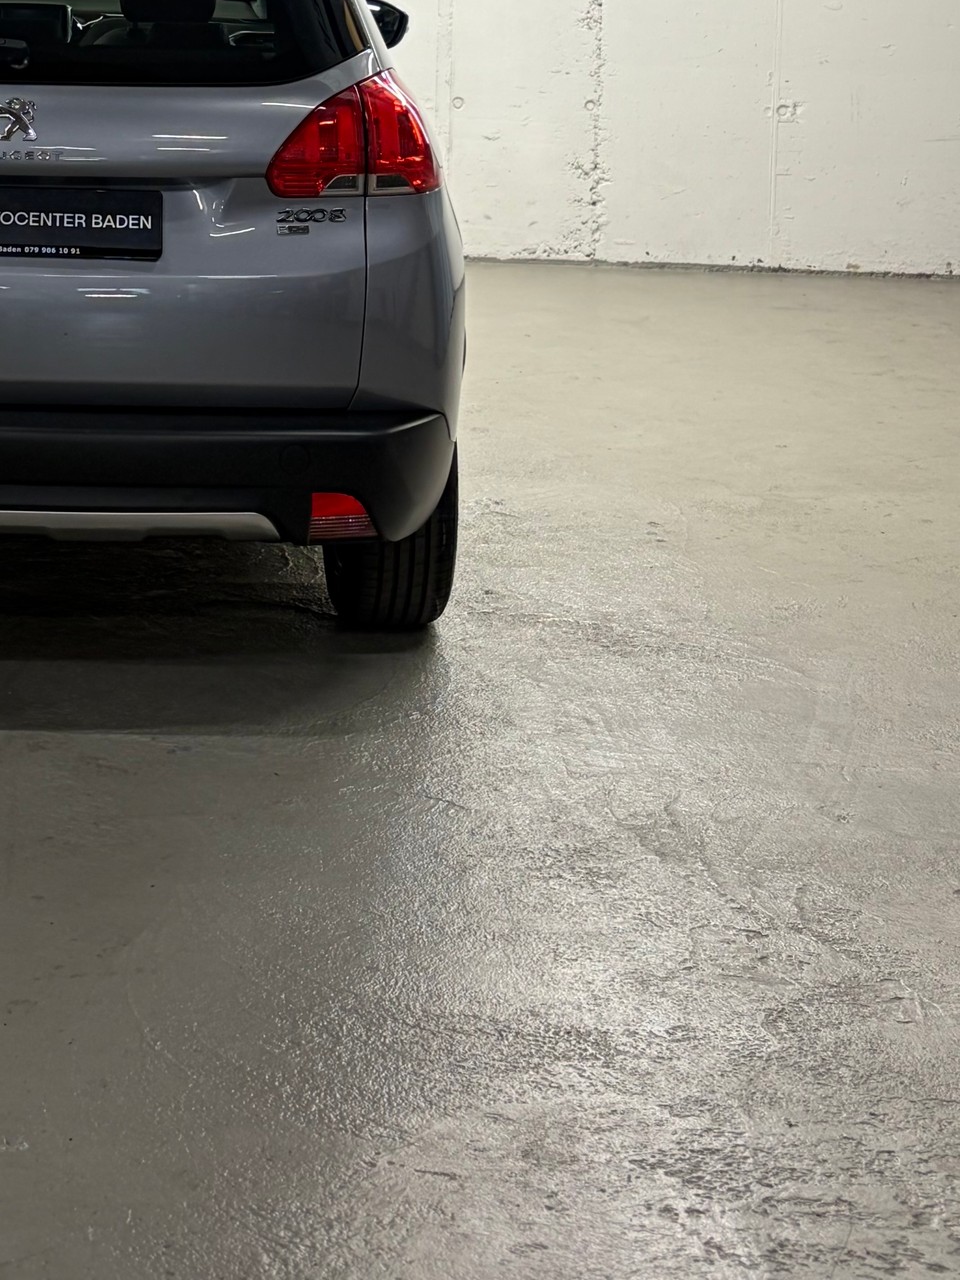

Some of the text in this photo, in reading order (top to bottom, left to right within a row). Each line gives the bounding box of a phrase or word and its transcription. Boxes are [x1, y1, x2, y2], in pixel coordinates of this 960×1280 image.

[91, 214, 152, 230] BADEN
[276, 207, 347, 223] 2008
[70, 247, 80, 255] 91
